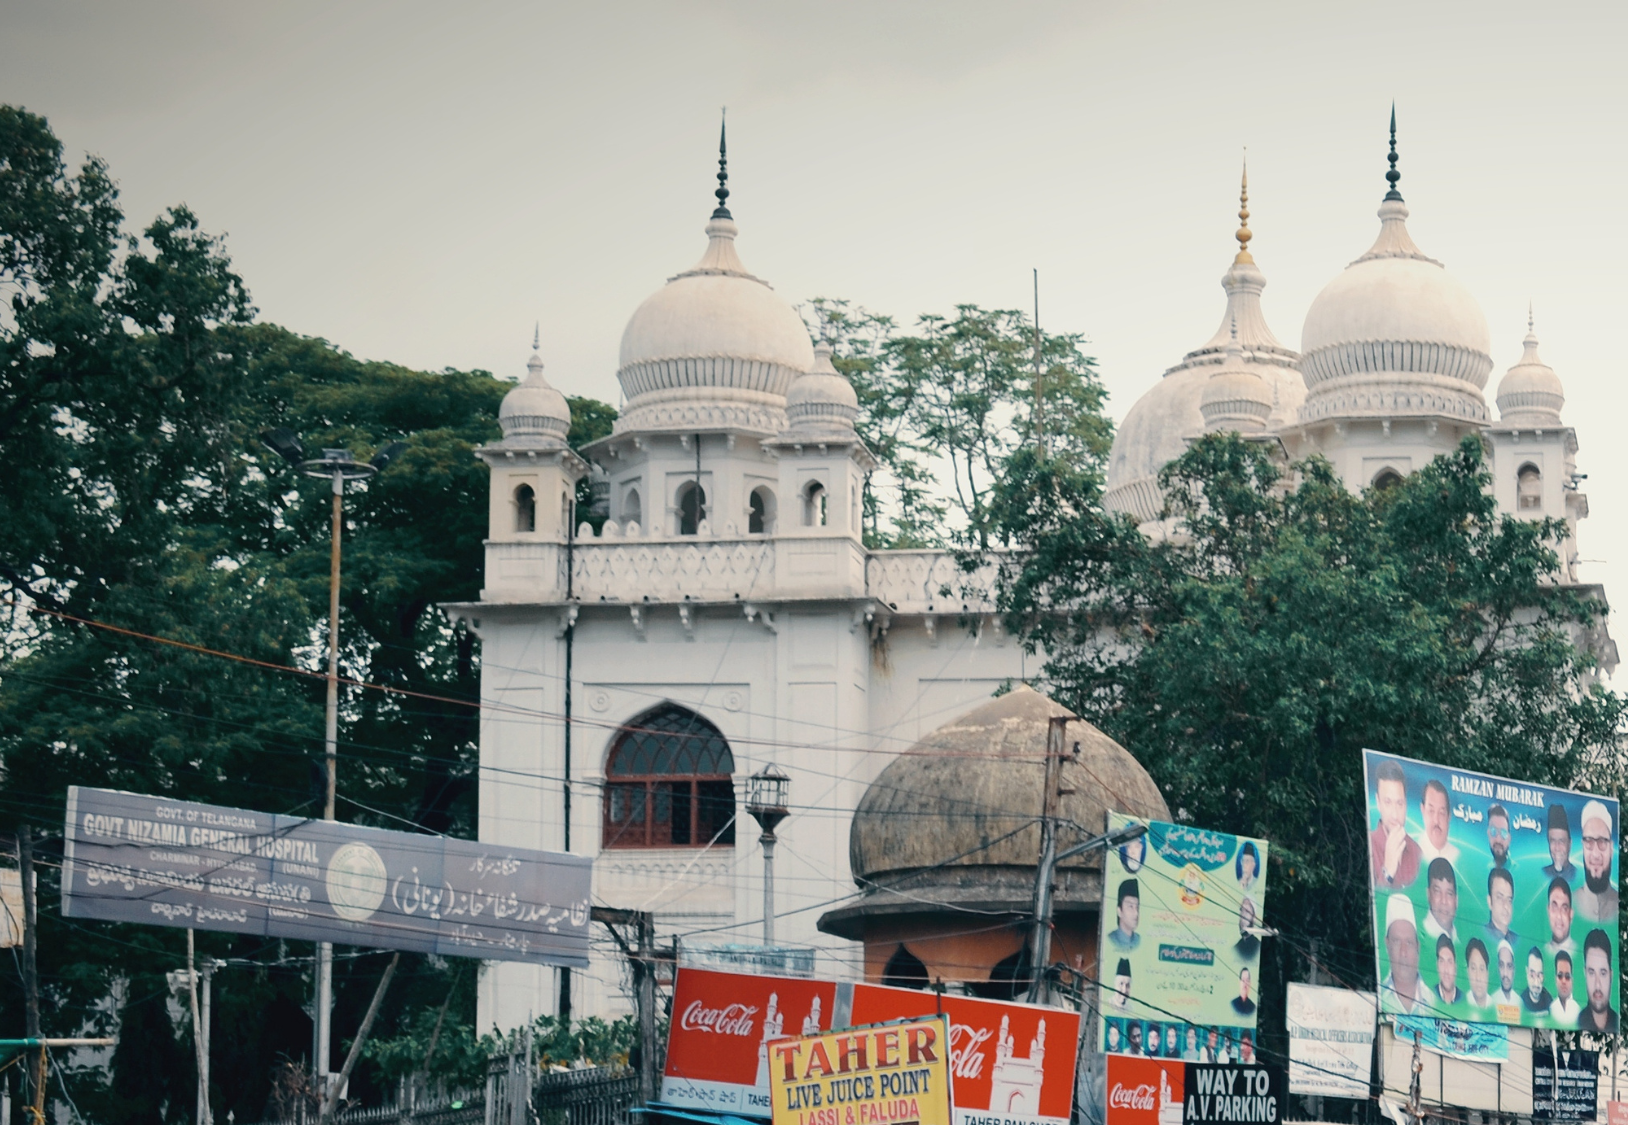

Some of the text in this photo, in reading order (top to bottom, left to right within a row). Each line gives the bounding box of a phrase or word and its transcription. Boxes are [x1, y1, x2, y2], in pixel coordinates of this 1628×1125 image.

[1451, 775, 1545, 808] RAMZAN MUBARAK
[156, 806, 256, 829] GOVT. OF TELANGANA
[83, 813, 319, 863] GOVT NIZAMIA GENERAL HOSPITAL
[150, 851, 200, 866] CHARMINAR
[282, 865, 320, 879] (UNANI)
[681, 1000, 759, 1036] Coca-Cola
[775, 1024, 939, 1084] TAHER
[787, 1068, 932, 1110] LIVE JUICE POINT
[1196, 1068, 1238, 1095] WAY
[1243, 1069, 1270, 1096] TO
[748, 1093, 772, 1107] TAHE
[1109, 1083, 1156, 1111] Coca-Cola
[845, 1106, 856, 1125] &
[860, 1098, 920, 1123] FALUDA
